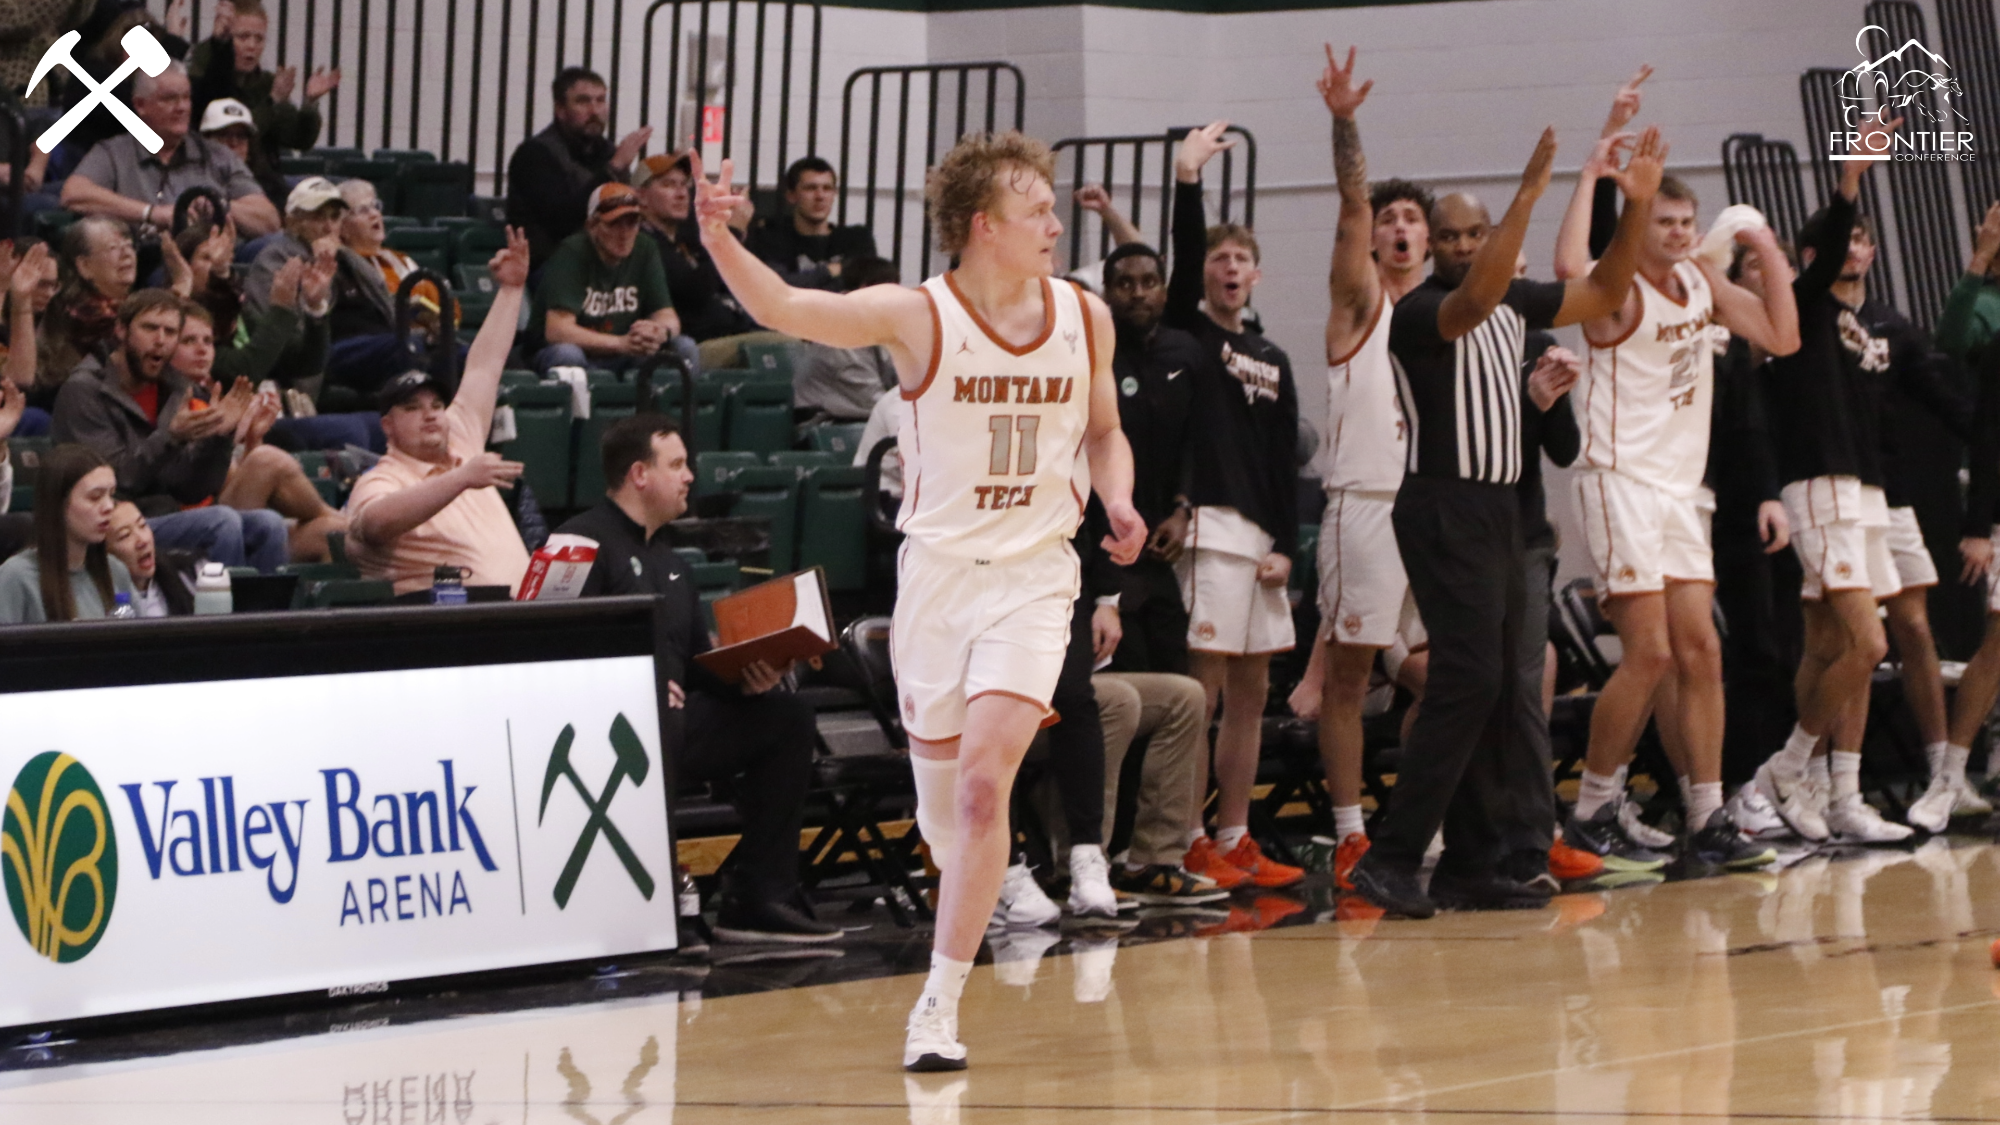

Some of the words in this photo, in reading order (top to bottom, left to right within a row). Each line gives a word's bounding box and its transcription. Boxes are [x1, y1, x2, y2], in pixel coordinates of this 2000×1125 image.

[988, 414, 1041, 476] 11
[118, 775, 311, 904] Valley
[318, 759, 499, 872] Bank
[339, 869, 473, 927] ARENA
